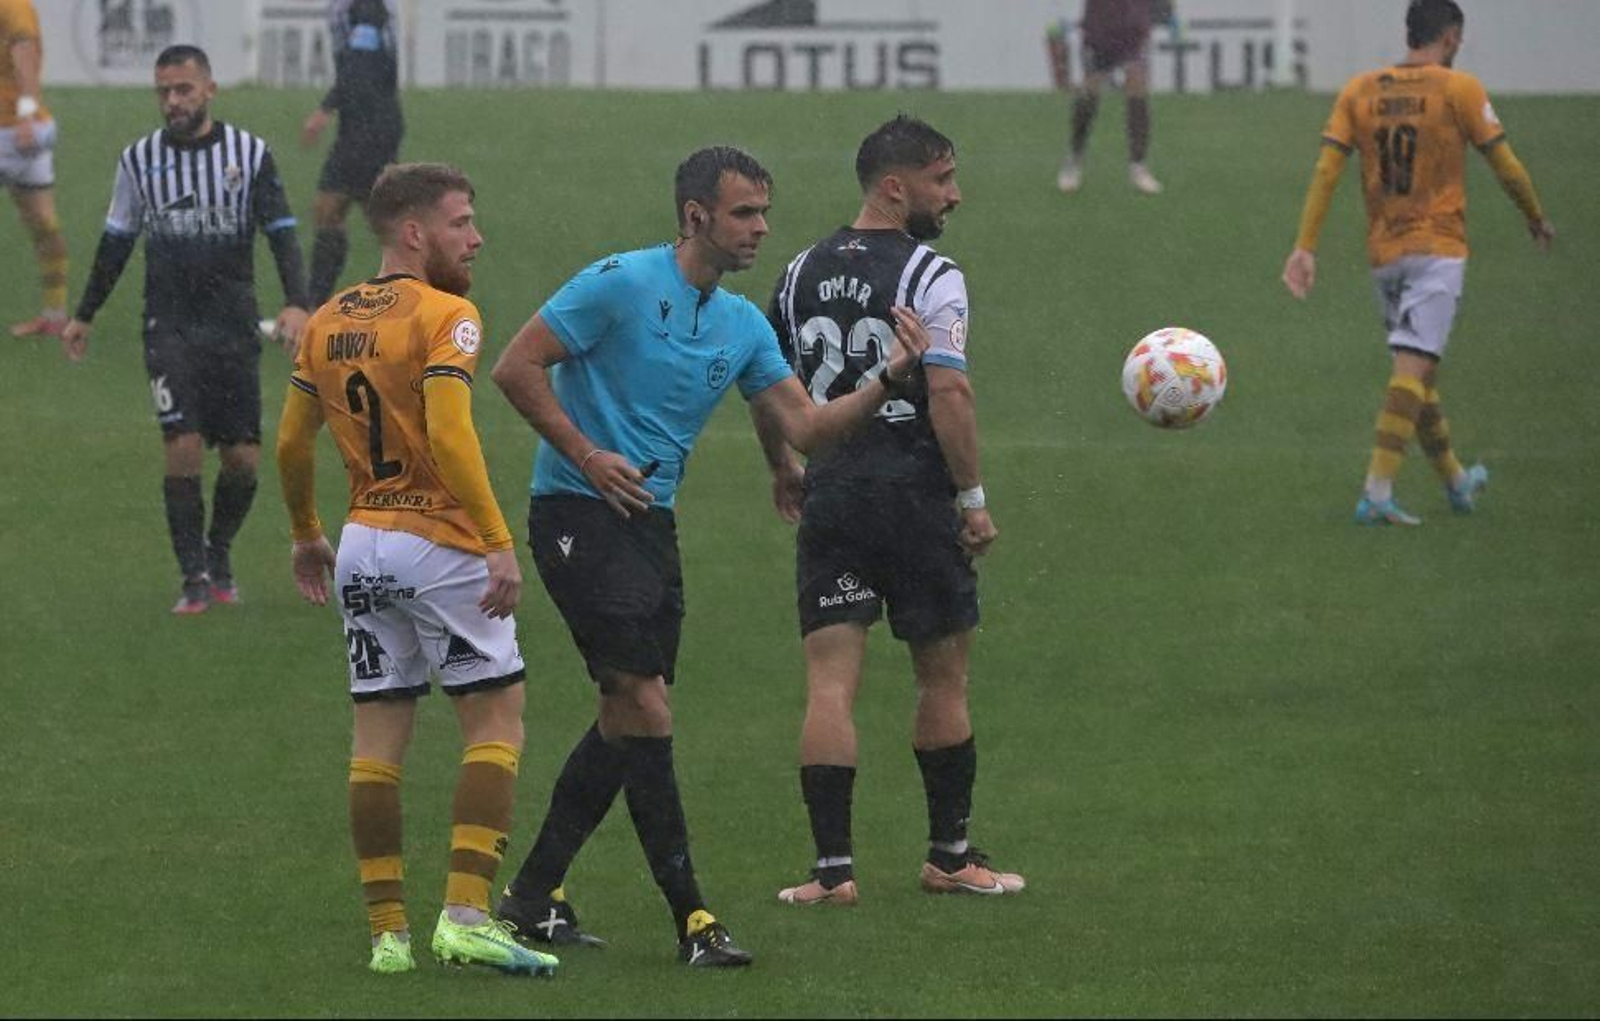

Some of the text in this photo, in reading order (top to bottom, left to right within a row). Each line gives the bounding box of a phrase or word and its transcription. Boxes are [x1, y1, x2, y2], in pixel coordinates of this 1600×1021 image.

[696, 41, 940, 90] LOTUS
[818, 275, 872, 309] OMAR
[345, 370, 403, 481] 2
